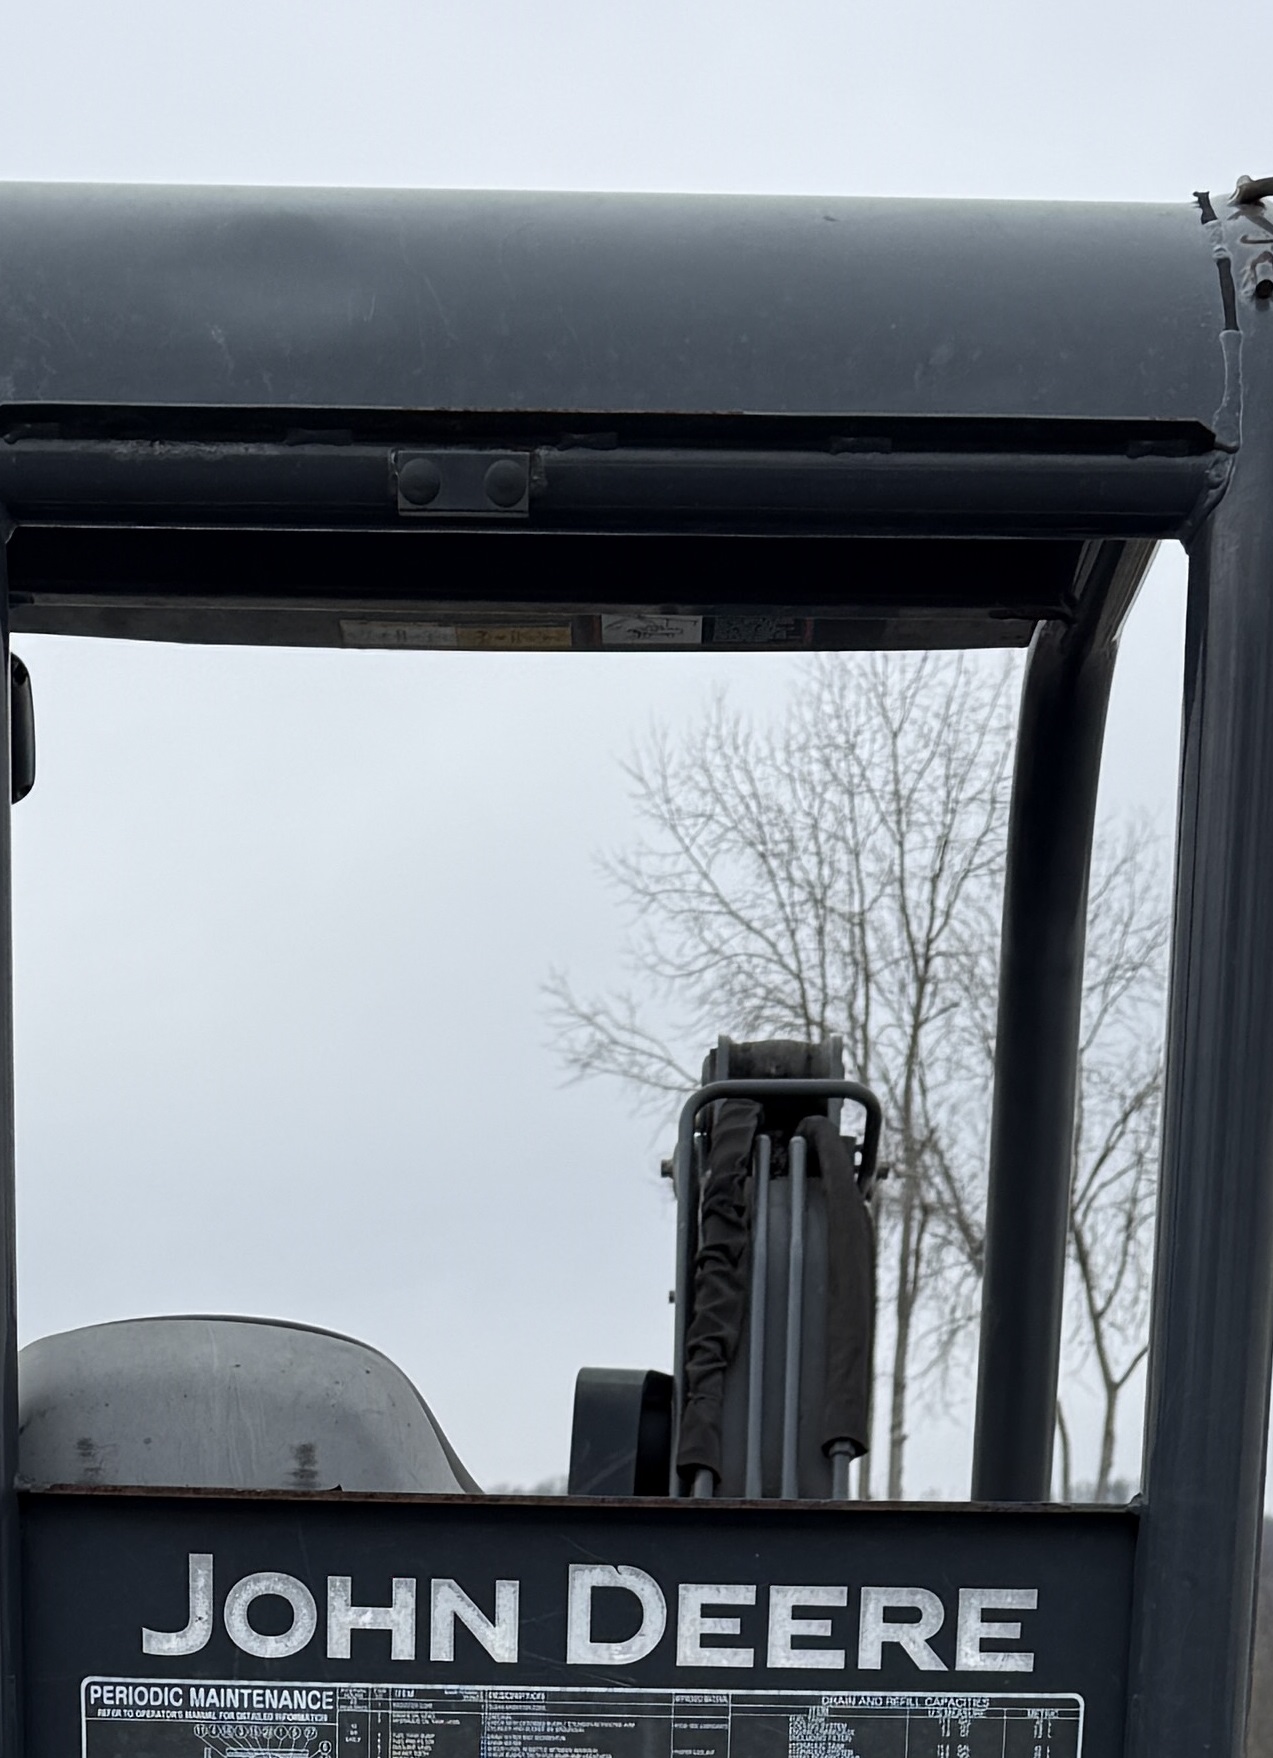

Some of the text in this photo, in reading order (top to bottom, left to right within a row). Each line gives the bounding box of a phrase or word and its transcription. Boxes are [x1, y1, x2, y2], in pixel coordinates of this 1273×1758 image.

[142, 1551, 1039, 1673] JOHN DEERE
[89, 1685, 183, 1707] PERIODIC
[189, 1687, 334, 1710] MAINTENANCE
[821, 1696, 990, 1709] DRAIN AND REFILL CAPACITIES
[124, 1709, 134, 1718] TO
